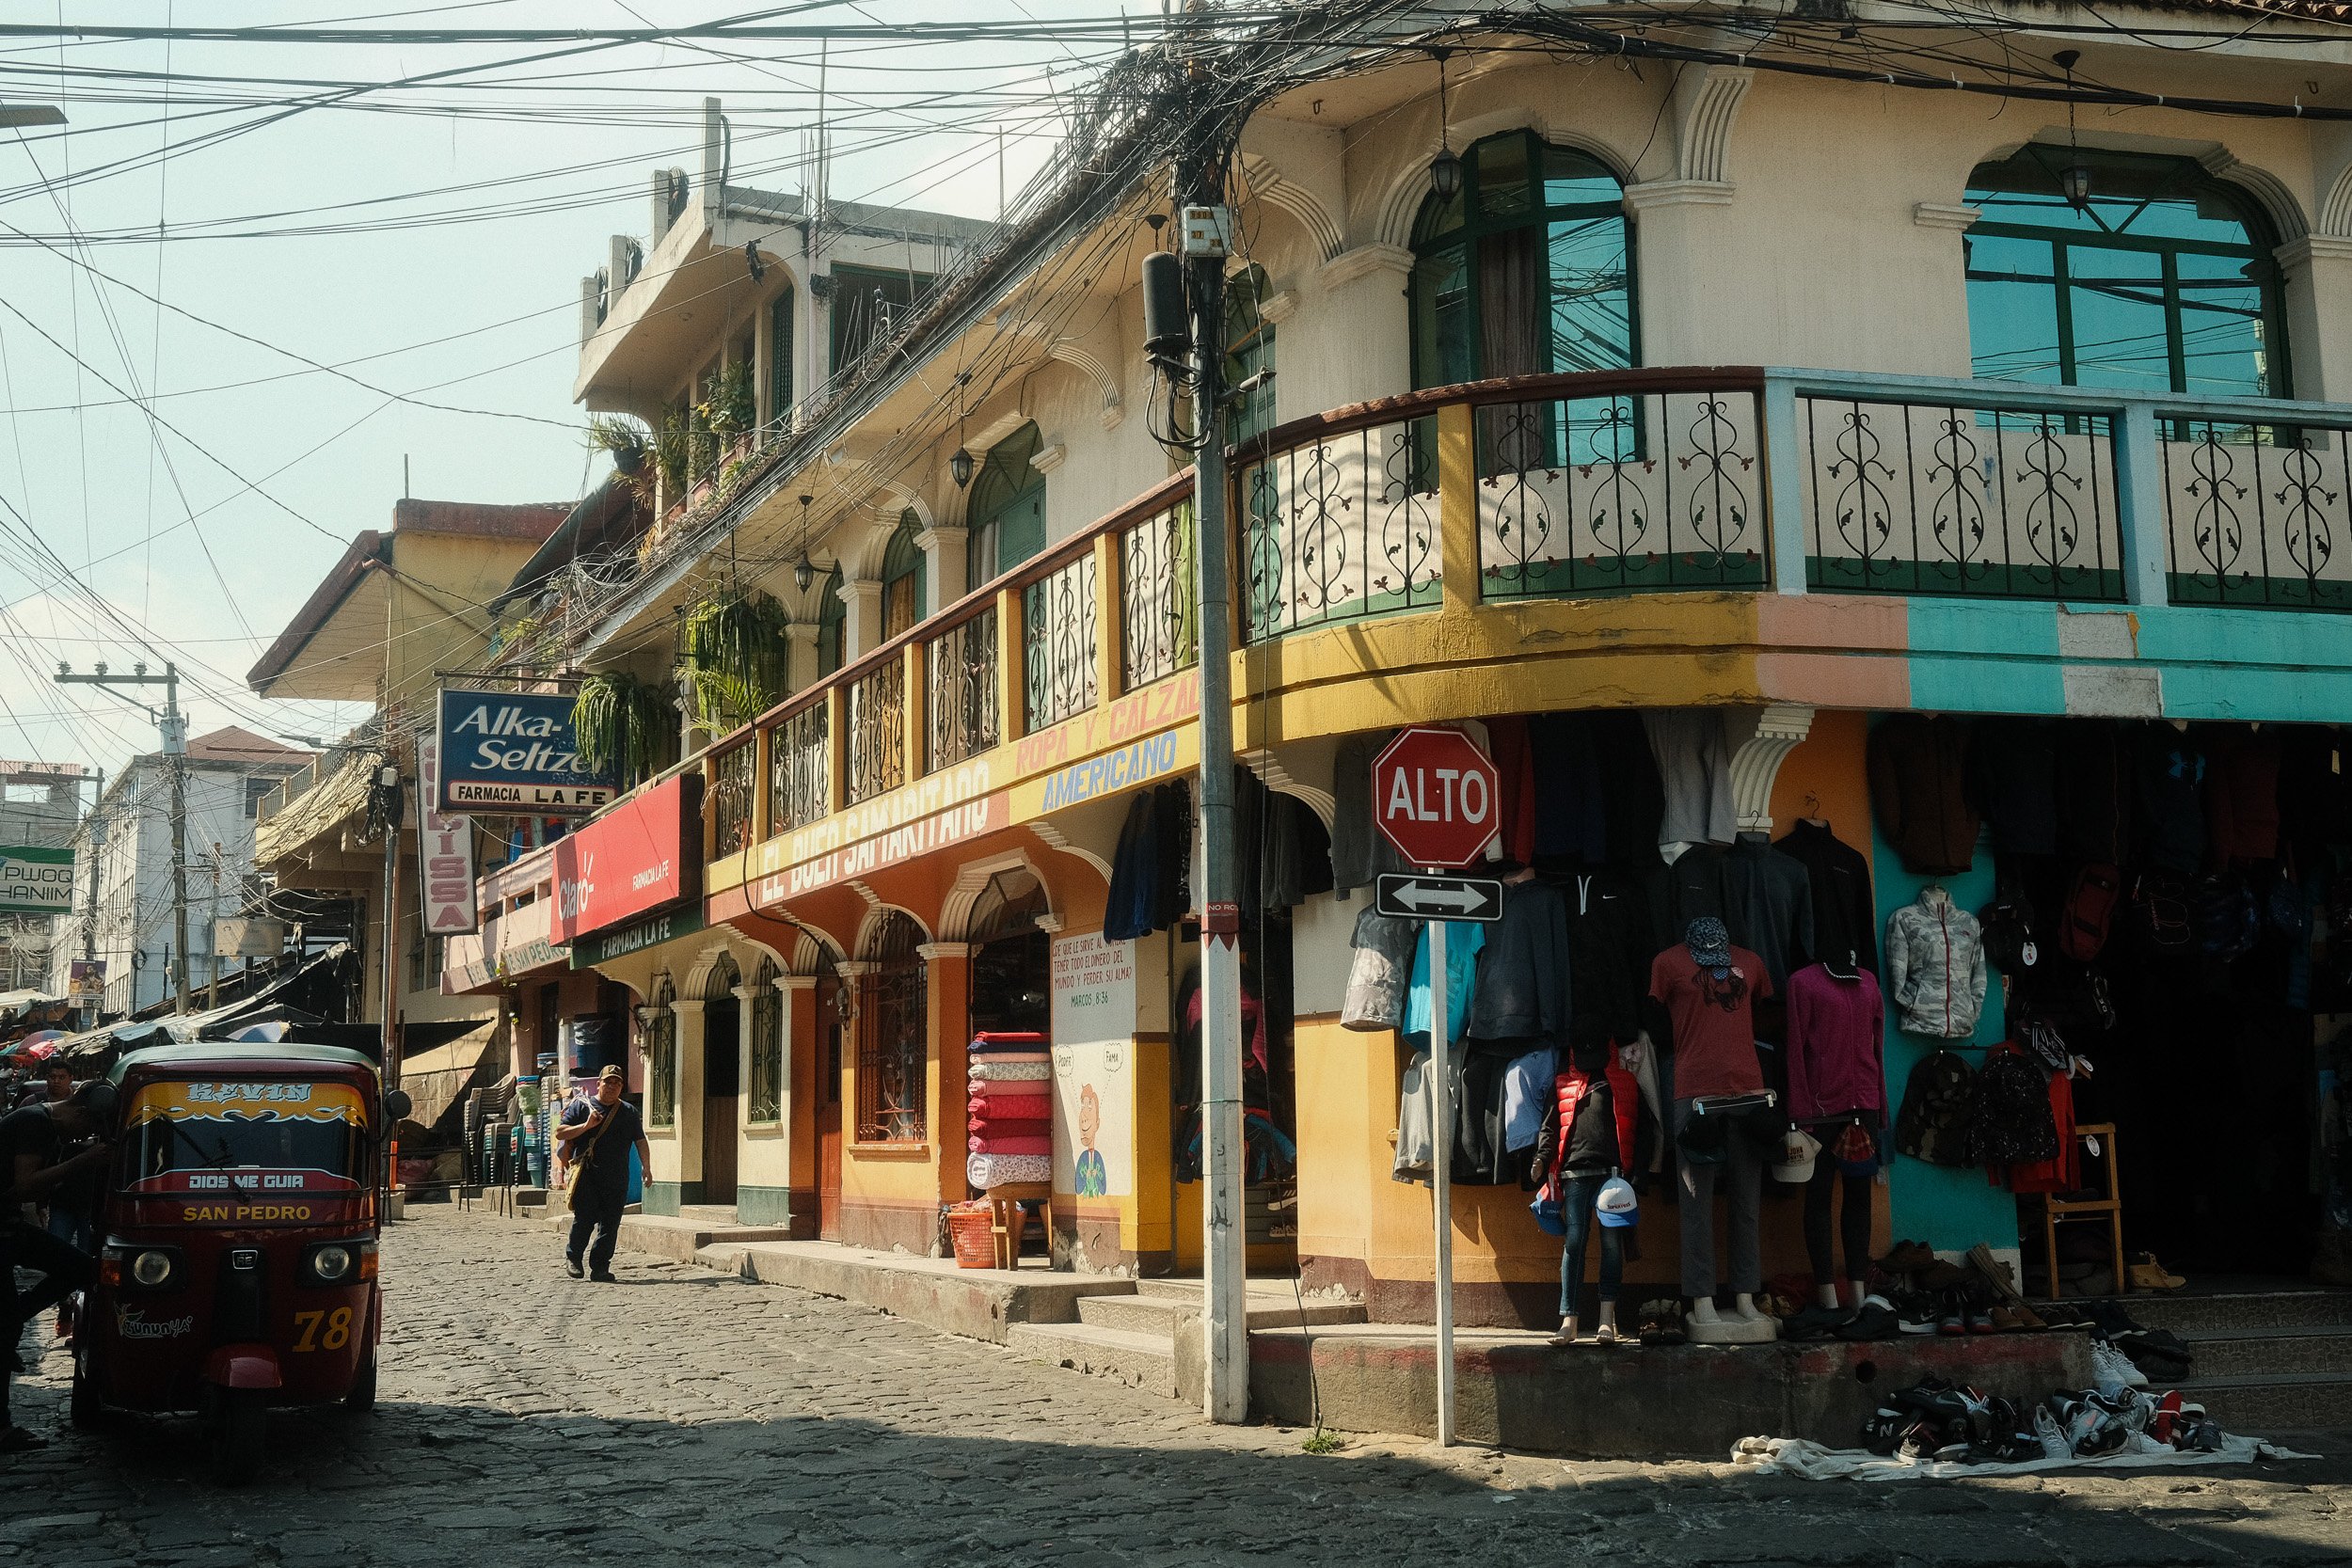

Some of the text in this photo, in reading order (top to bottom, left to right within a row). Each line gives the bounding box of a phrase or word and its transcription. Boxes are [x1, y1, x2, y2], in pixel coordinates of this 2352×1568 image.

[453, 705, 562, 737] Alka-
[1016, 727, 1068, 776] ROPA
[1084, 711, 1099, 752] Y
[1041, 731, 1176, 813] AMERICANO
[458, 786, 606, 804] FARMACIA LA FE
[1387, 767, 1488, 824] ALTO
[762, 760, 989, 903] EL BUEN SAMARITANO
[5, 866, 72, 882] PWOQ
[632, 859, 669, 892] FARMACIA LA FE
[559, 877, 590, 921] Claro
[602, 916, 671, 959] FARMACIA LA FE
[1062, 942, 1073, 955] QUE
[1073, 941, 1079, 954] LE
[1080, 938, 1094, 953] SIRVE
[1096, 937, 1103, 949] AL
[1071, 957, 1084, 971] TODO
[1113, 950, 1123, 963] DEL
[1055, 967, 1132, 990] MUNDO Y PERDER SU ALMA?
[186, 1084, 312, 1104] KEVIN
[189, 1176, 304, 1189] DIOS ME GUIA
[183, 1206, 311, 1221] SAN PEDRO
[293, 1307, 352, 1353] 78
